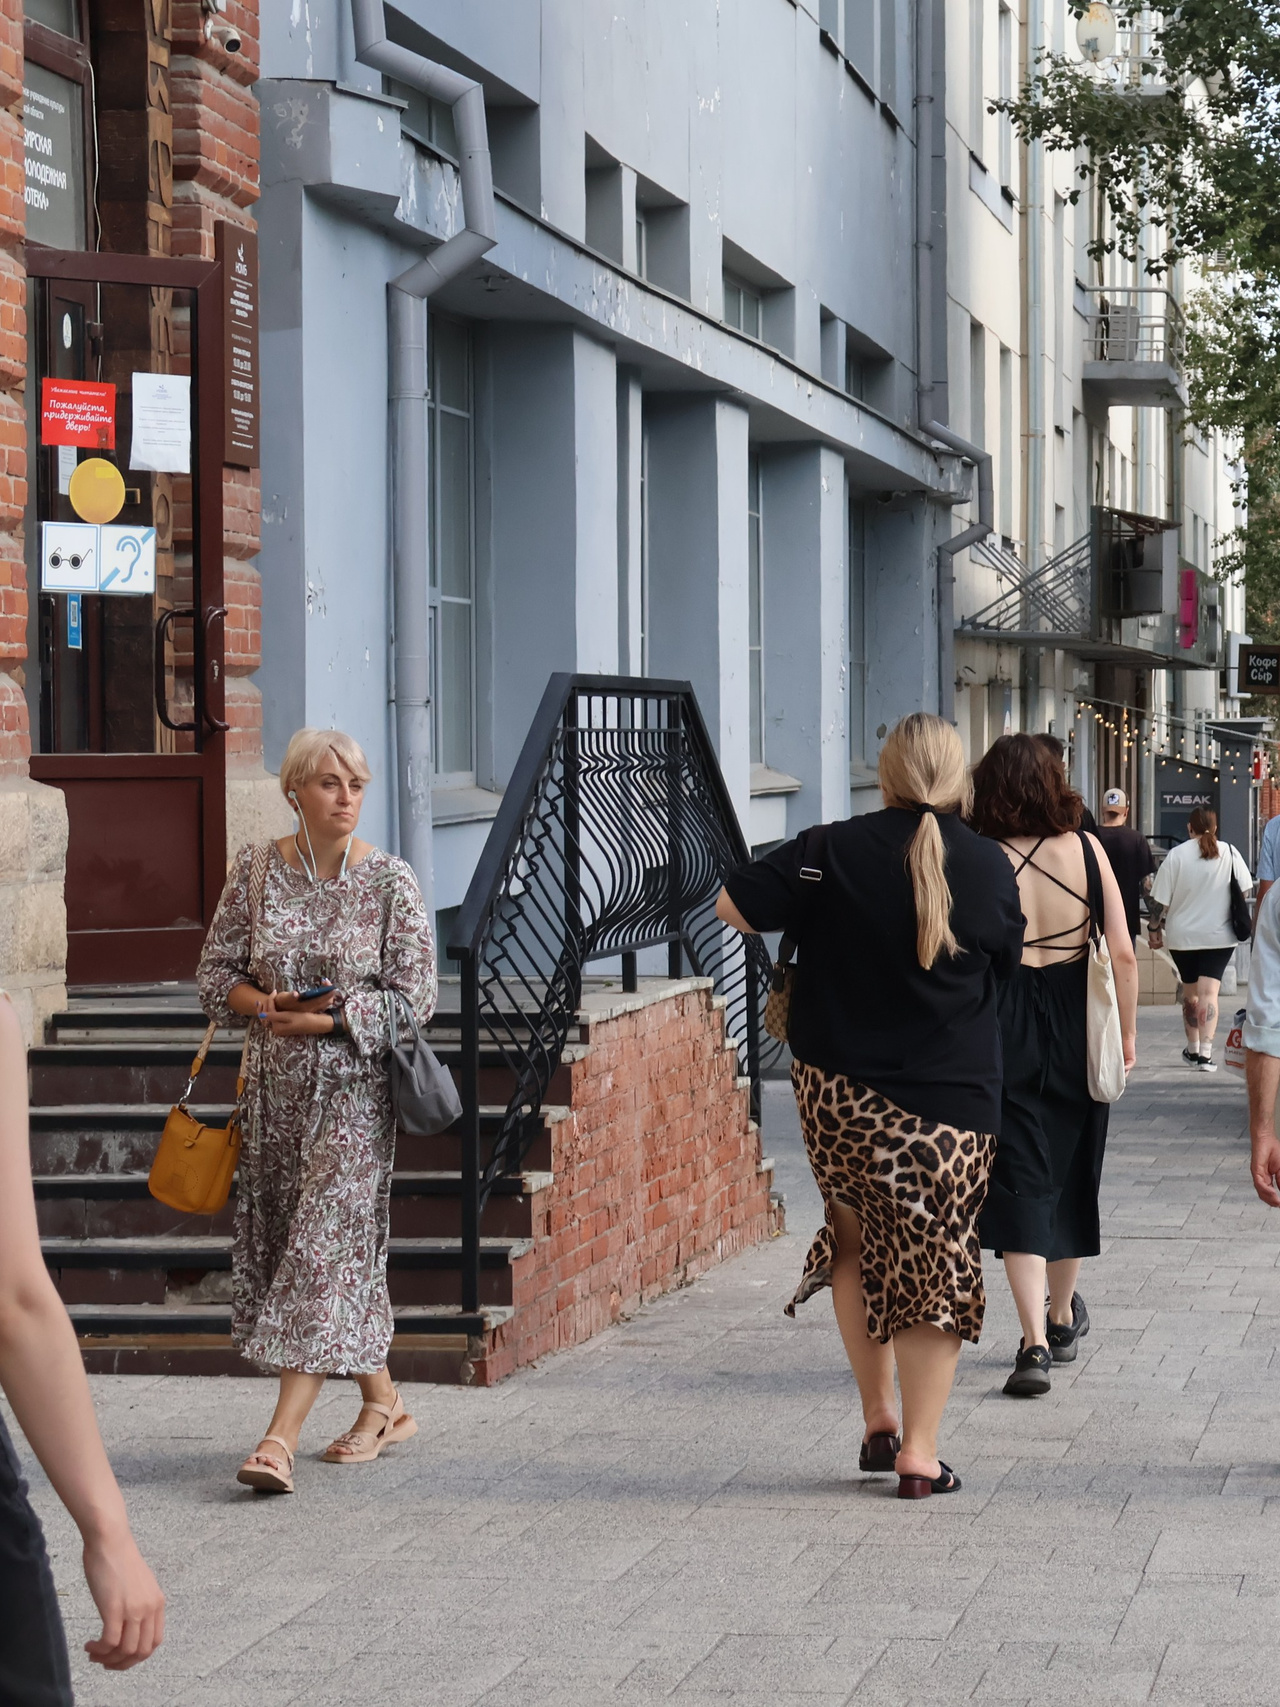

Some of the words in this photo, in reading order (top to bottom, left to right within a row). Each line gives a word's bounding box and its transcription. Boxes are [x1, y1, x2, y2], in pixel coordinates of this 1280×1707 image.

[49, 399, 108, 413] Пожалуйста,
[43, 409, 113, 423] придерживайте
[65, 420, 91, 433] дверь!
[1249, 655, 1278, 670] Кофе
[1250, 668, 1273, 684] Сыр
[1163, 794, 1211, 805] ТАБАК
